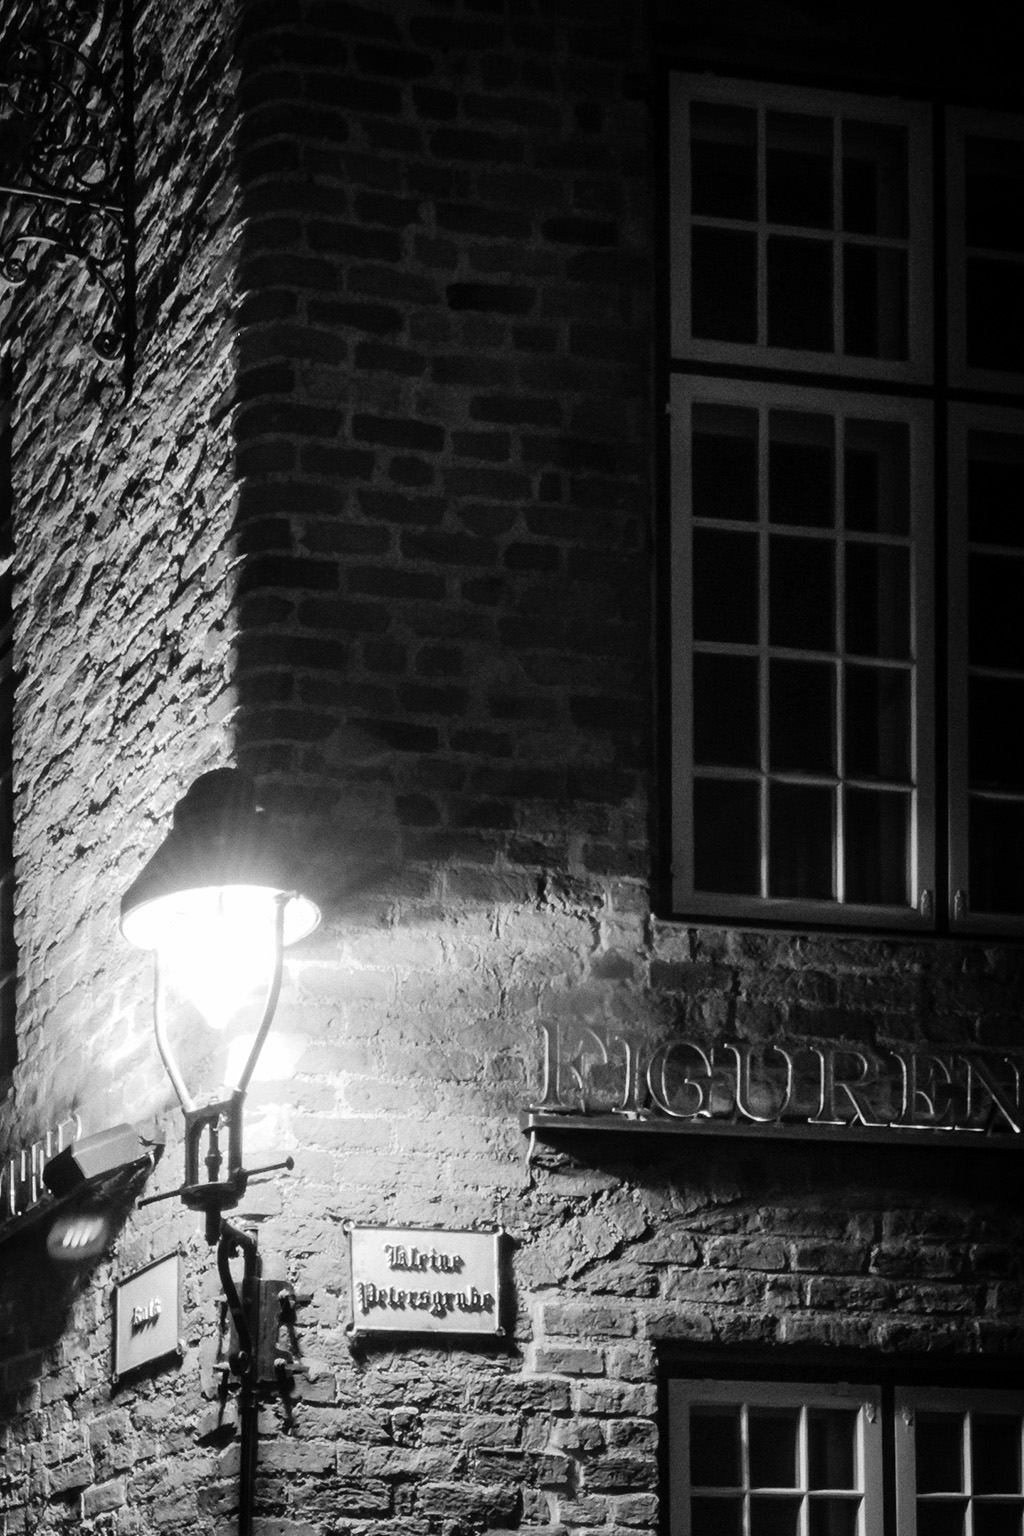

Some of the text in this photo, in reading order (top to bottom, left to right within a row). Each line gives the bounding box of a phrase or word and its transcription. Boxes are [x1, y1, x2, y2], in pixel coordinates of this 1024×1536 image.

[528, 1022, 1022, 1134] FIGUREN
[383, 1244, 466, 1274] Kleine
[356, 1282, 496, 1319] Petersgrube
